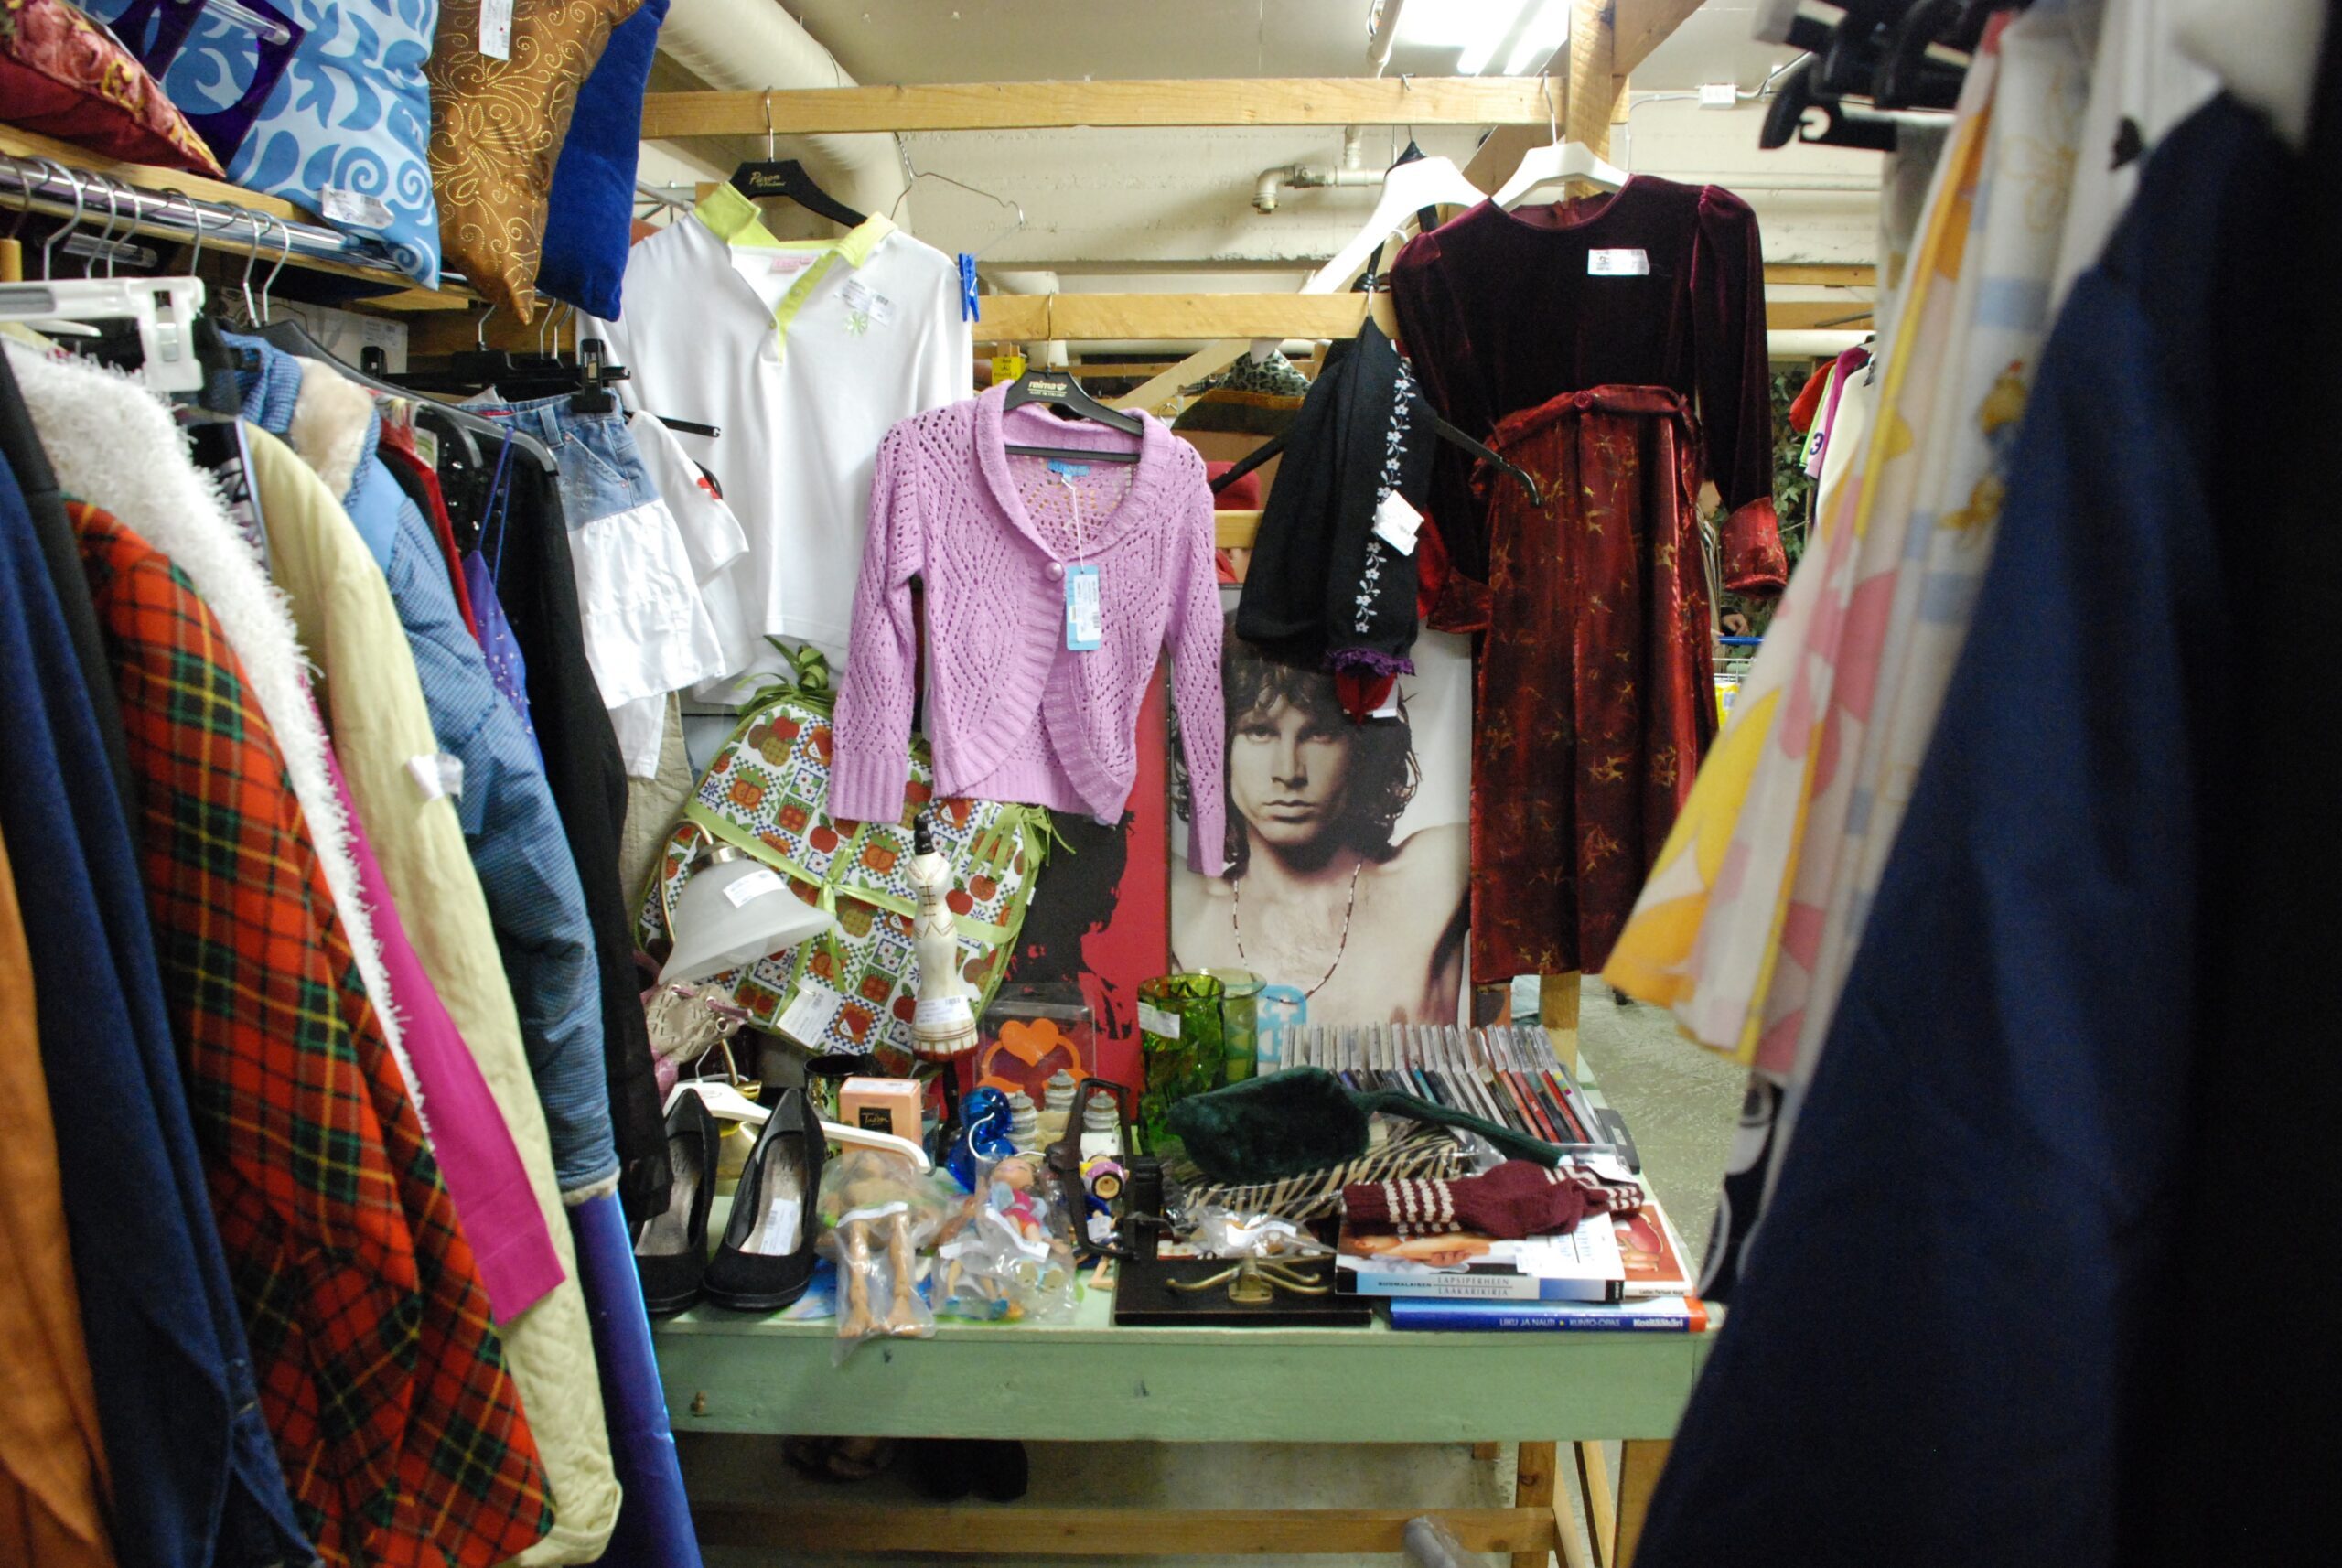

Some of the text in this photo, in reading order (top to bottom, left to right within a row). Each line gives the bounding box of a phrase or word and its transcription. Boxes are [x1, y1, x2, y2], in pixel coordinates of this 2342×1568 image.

[1810, 432, 1824, 455] 3
[1437, 1276, 1509, 1285] LAPSIPERHEEN
[1520, 1318, 1531, 1326] JA
[1569, 1318, 1620, 1326] KUNTO-OPAS
